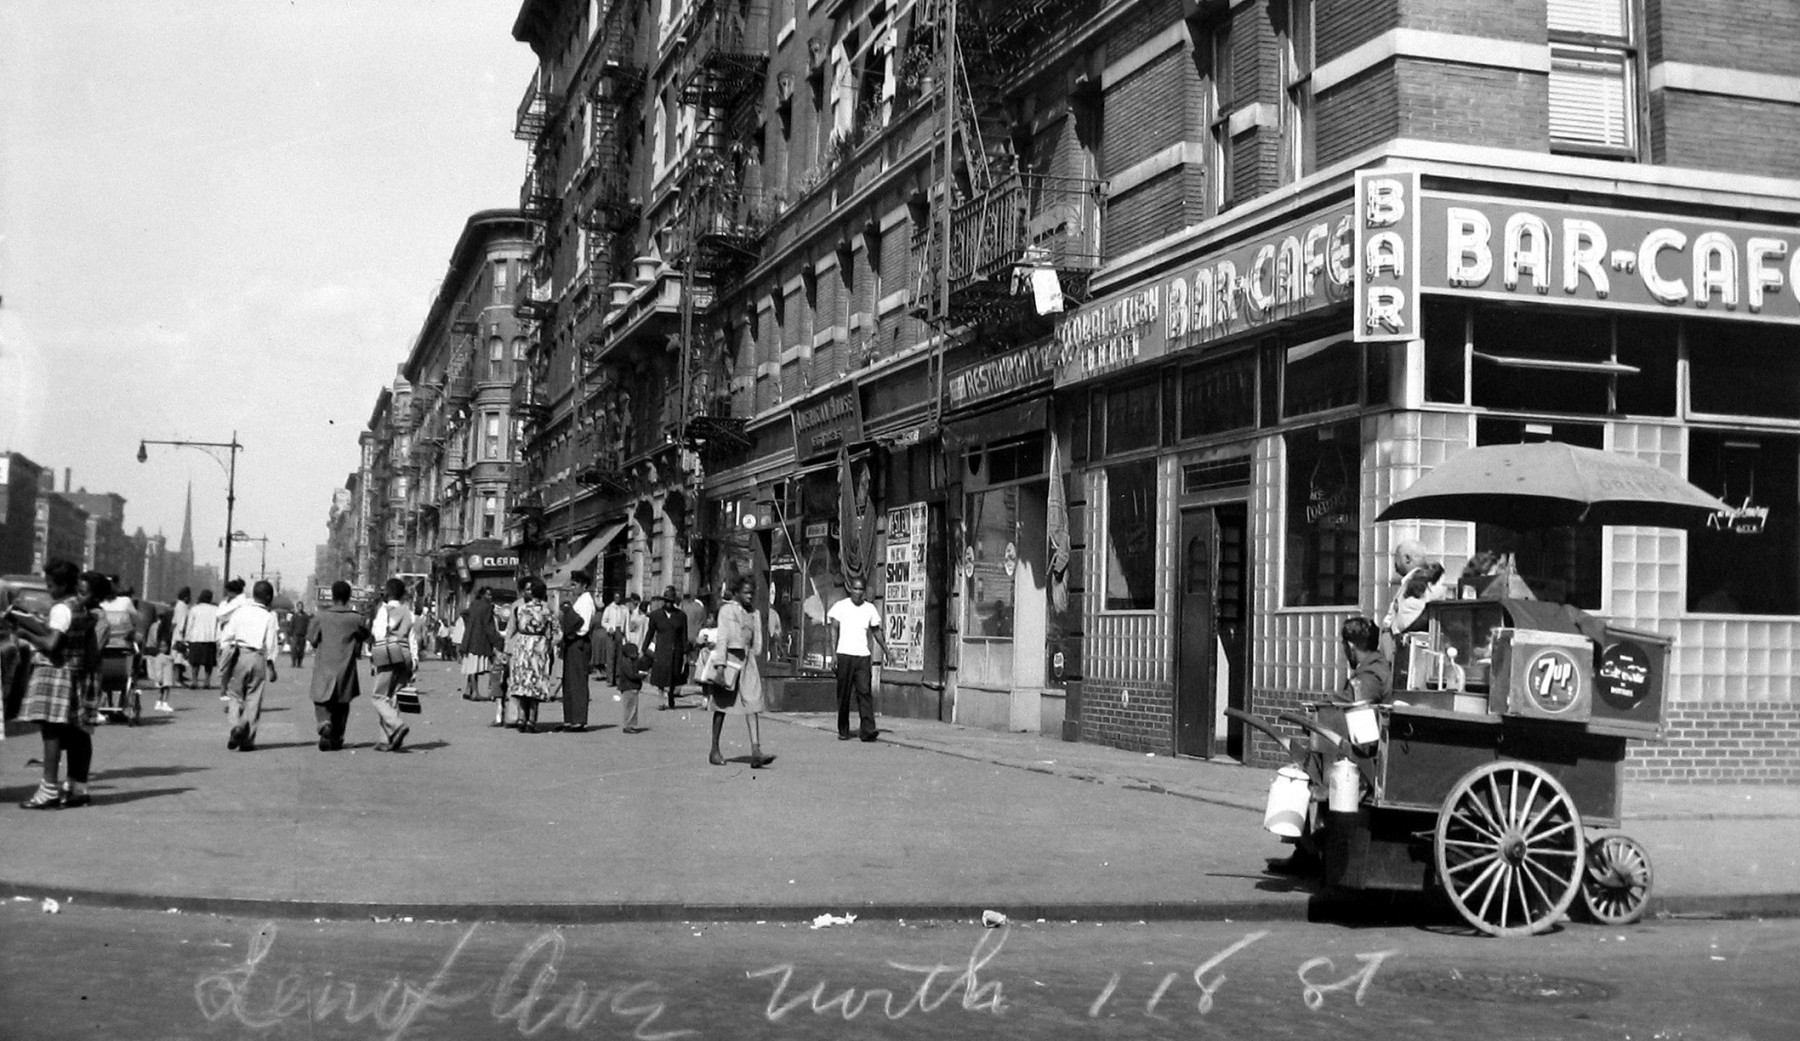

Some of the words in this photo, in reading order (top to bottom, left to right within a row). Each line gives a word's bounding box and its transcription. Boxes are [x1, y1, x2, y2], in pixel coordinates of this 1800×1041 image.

[1366, 178, 1405, 331] BAR
[1447, 206, 1800, 314] BAR-CAF
[965, 345, 1039, 398] RESTAURANT
